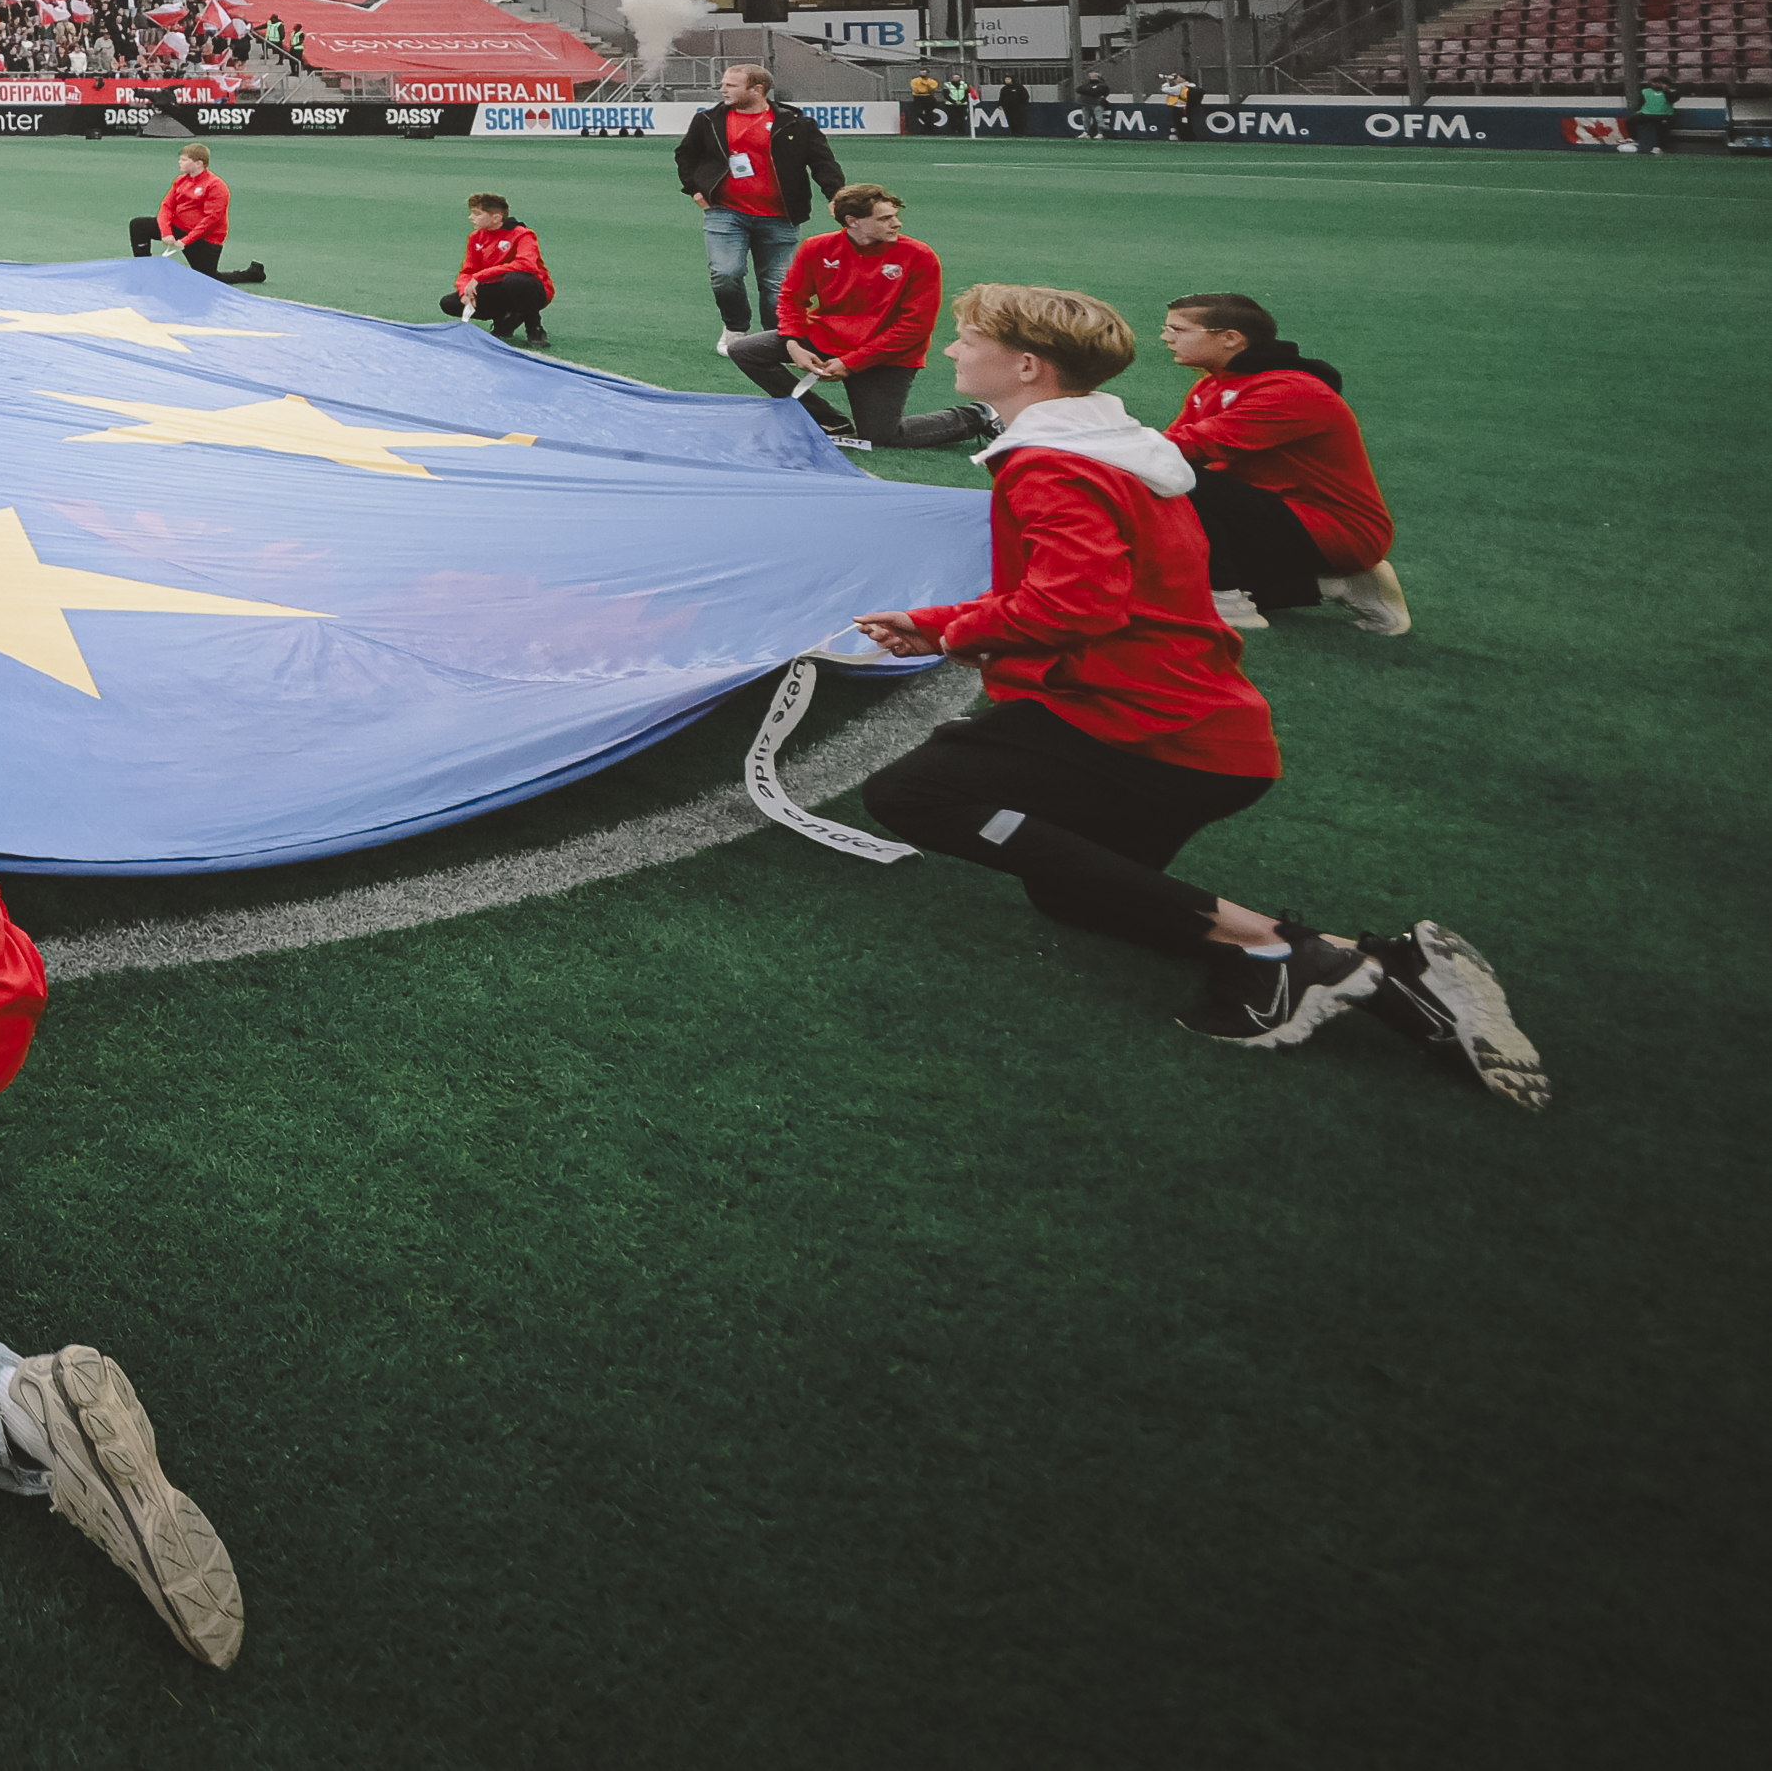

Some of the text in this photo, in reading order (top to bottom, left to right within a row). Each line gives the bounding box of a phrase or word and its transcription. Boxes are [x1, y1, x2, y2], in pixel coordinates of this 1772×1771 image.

[823, 21, 905, 46] UTB
[395, 83, 566, 102] KOOTINFRA.NL
[197, 108, 252, 125] DASSY
[291, 108, 348, 124] DASSY
[385, 108, 443, 124] DASSY
[782, 807, 903, 853] onder
